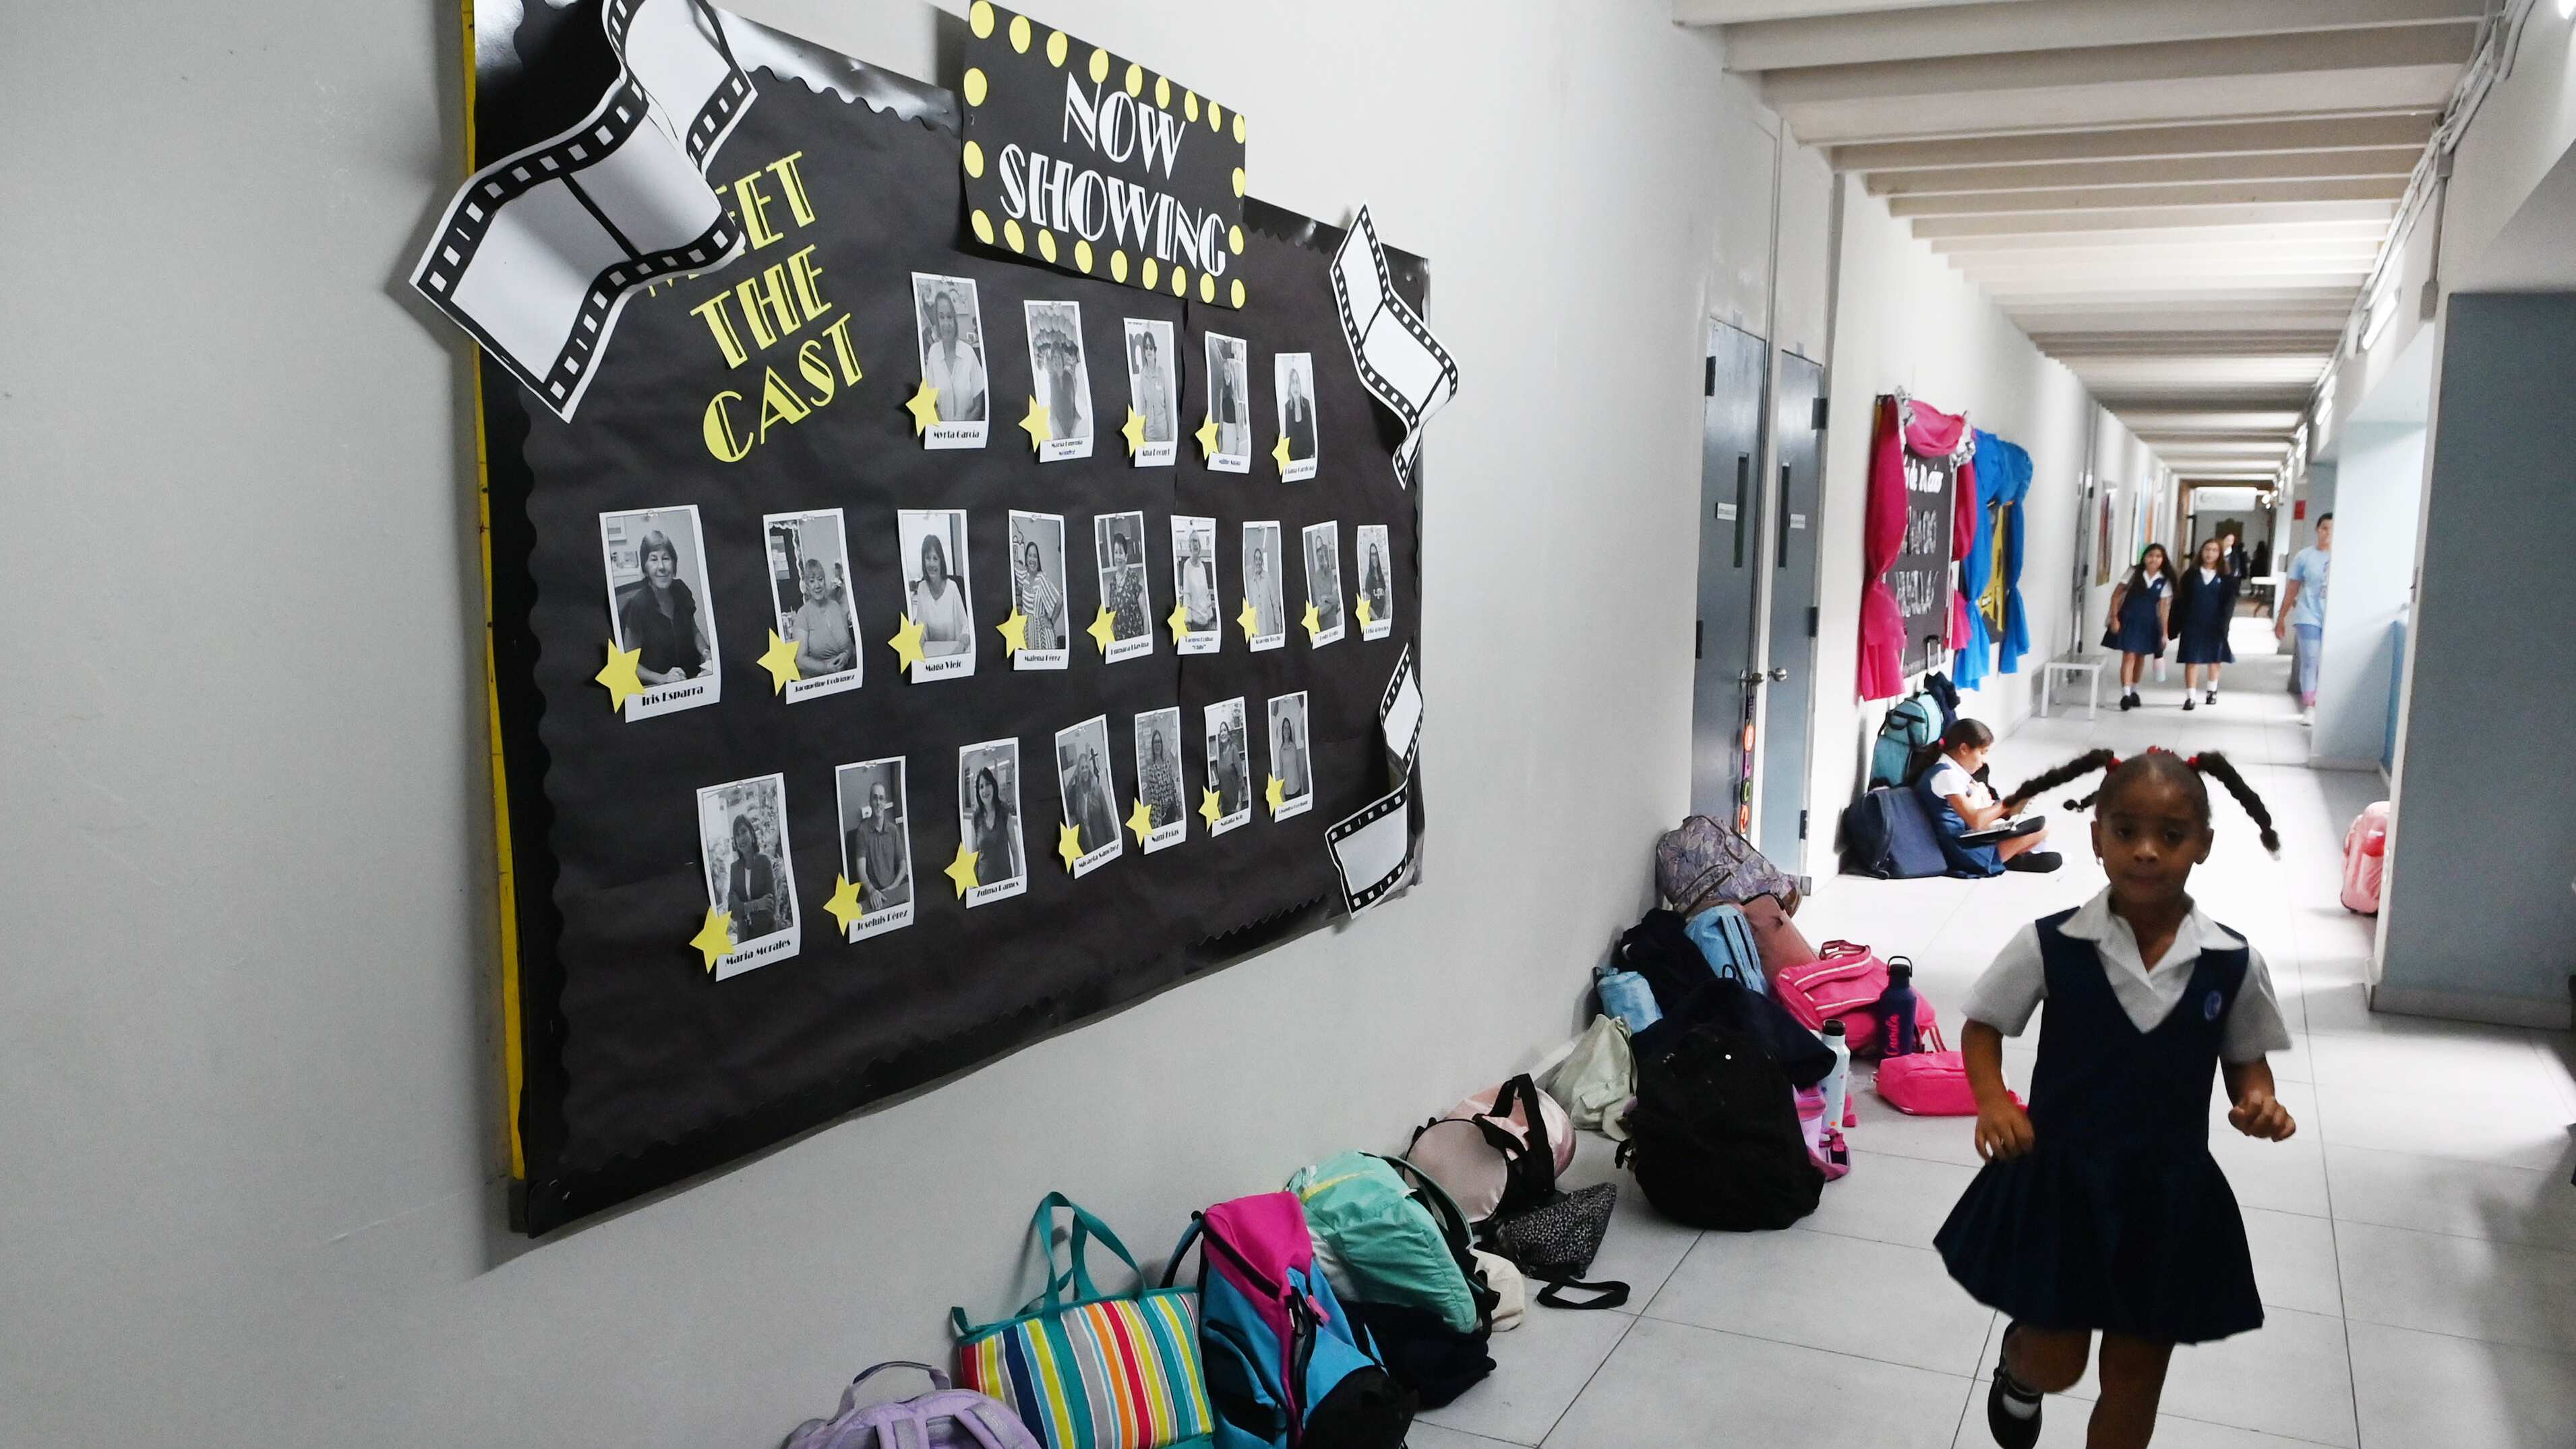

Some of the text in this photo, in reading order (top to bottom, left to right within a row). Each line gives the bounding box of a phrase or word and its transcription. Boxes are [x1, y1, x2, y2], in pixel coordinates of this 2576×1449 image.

[1063, 71, 1186, 180] NOW
[999, 144, 1225, 276] SHOWING
[690, 244, 832, 369] THE
[703, 313, 863, 463] CAST
[642, 686, 703, 706] Iris Esparra
[754, 939, 791, 956] Morales
